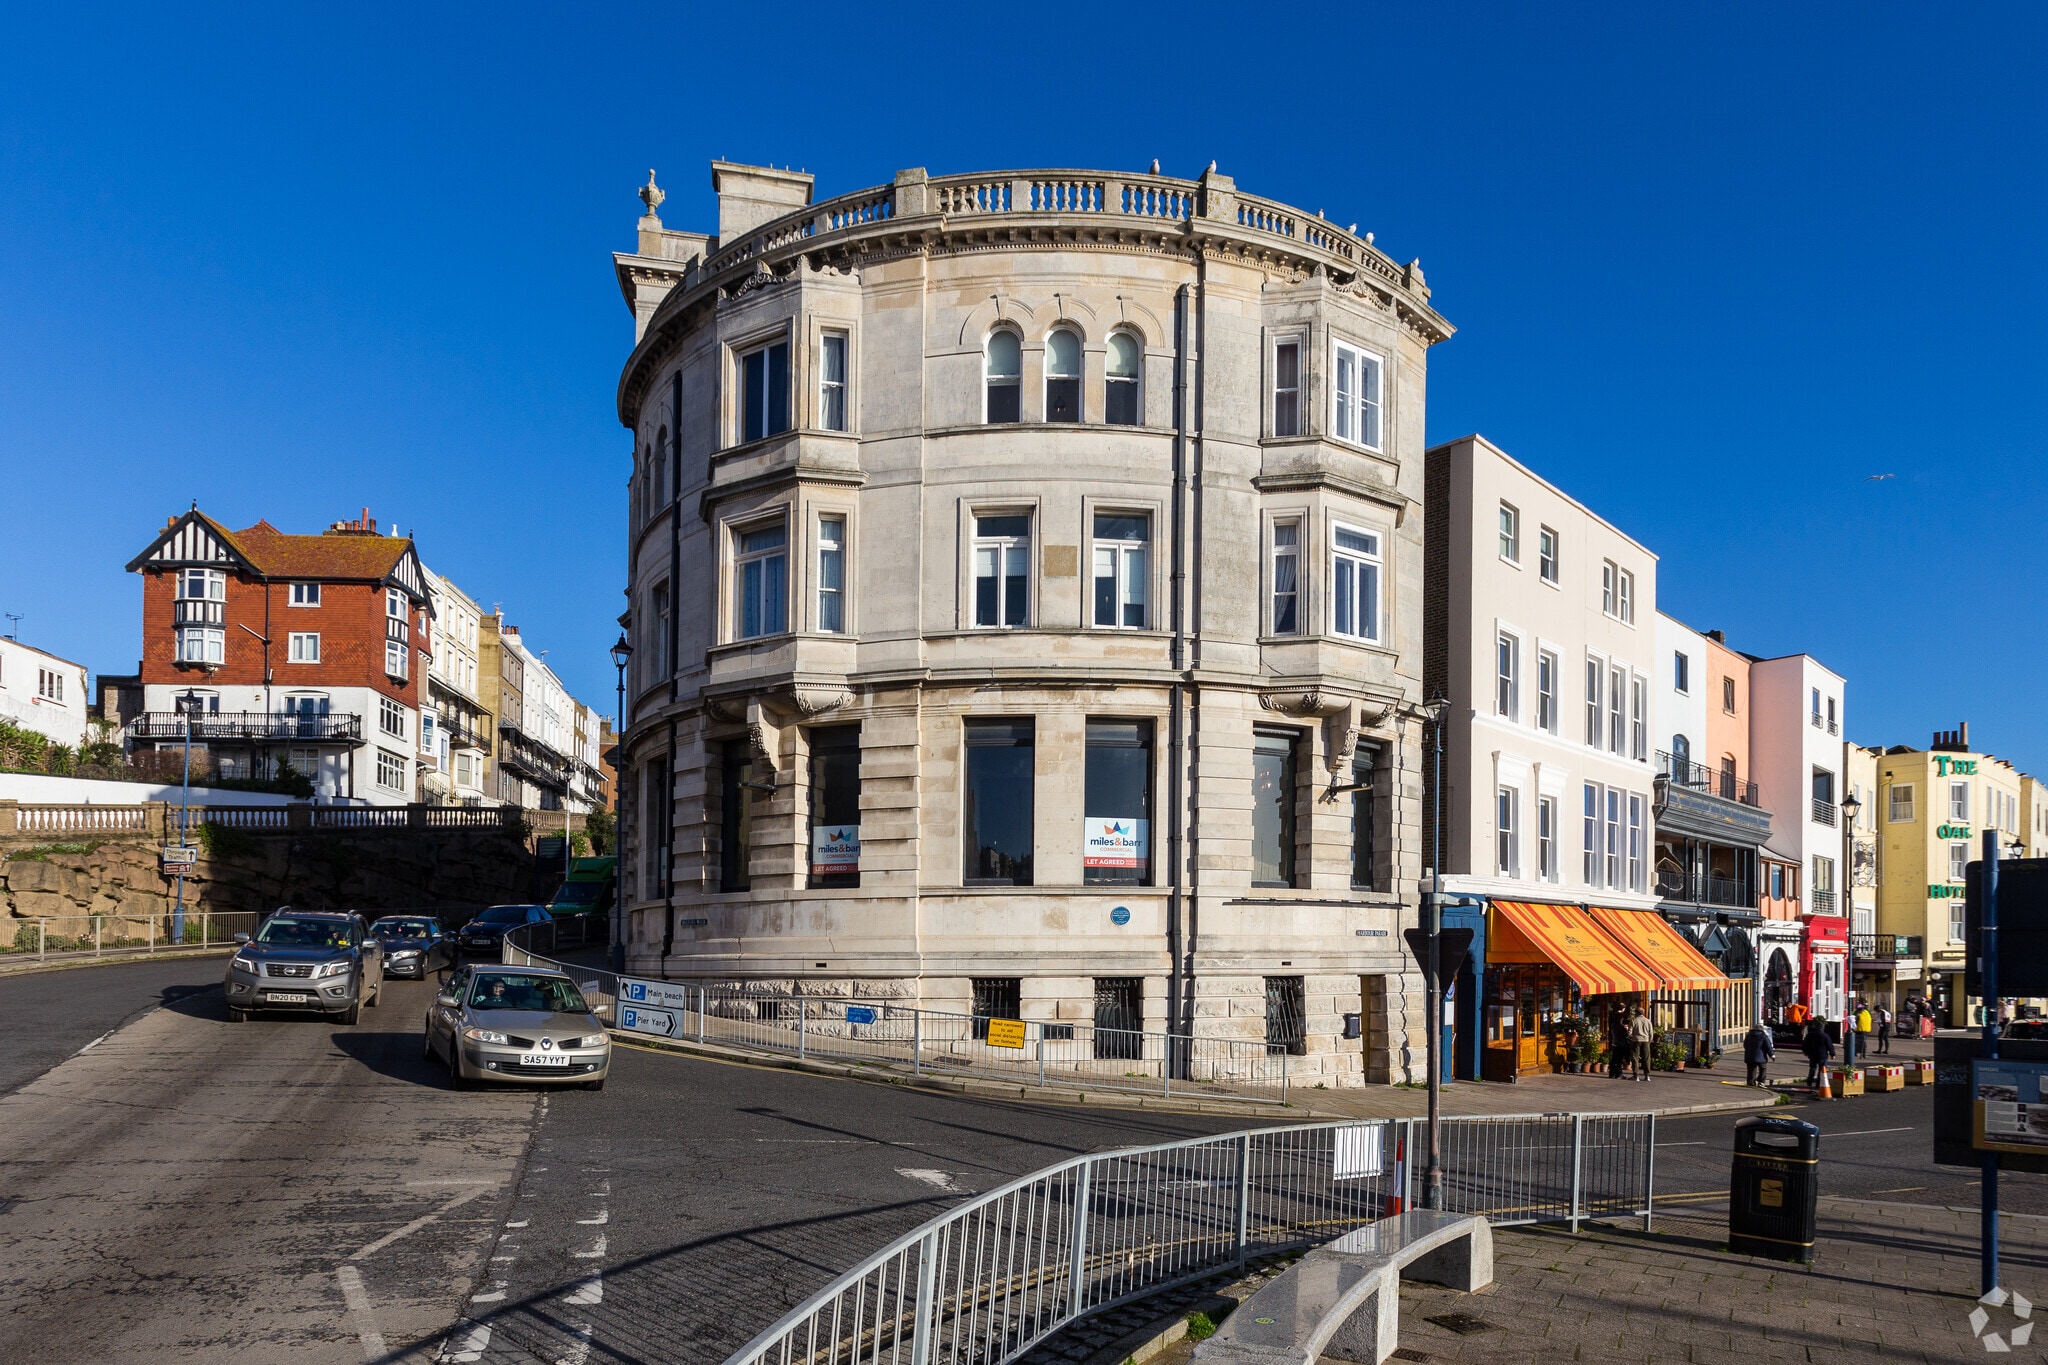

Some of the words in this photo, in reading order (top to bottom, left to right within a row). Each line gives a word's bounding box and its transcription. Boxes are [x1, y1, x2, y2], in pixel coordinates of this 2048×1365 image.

[1934, 755, 1978, 777] THE
[1938, 824, 1973, 839] OAK
[1090, 837, 1142, 846] miles&barr
[632, 985, 640, 998] P
[647, 989, 662, 997] Main
[664, 991, 683, 1000] beach
[626, 1012, 634, 1025] P
[637, 1016, 649, 1025] Pier
[651, 1018, 666, 1027] Yard
[524, 1055, 547, 1064] SA57
[549, 1056, 566, 1064] YYT
